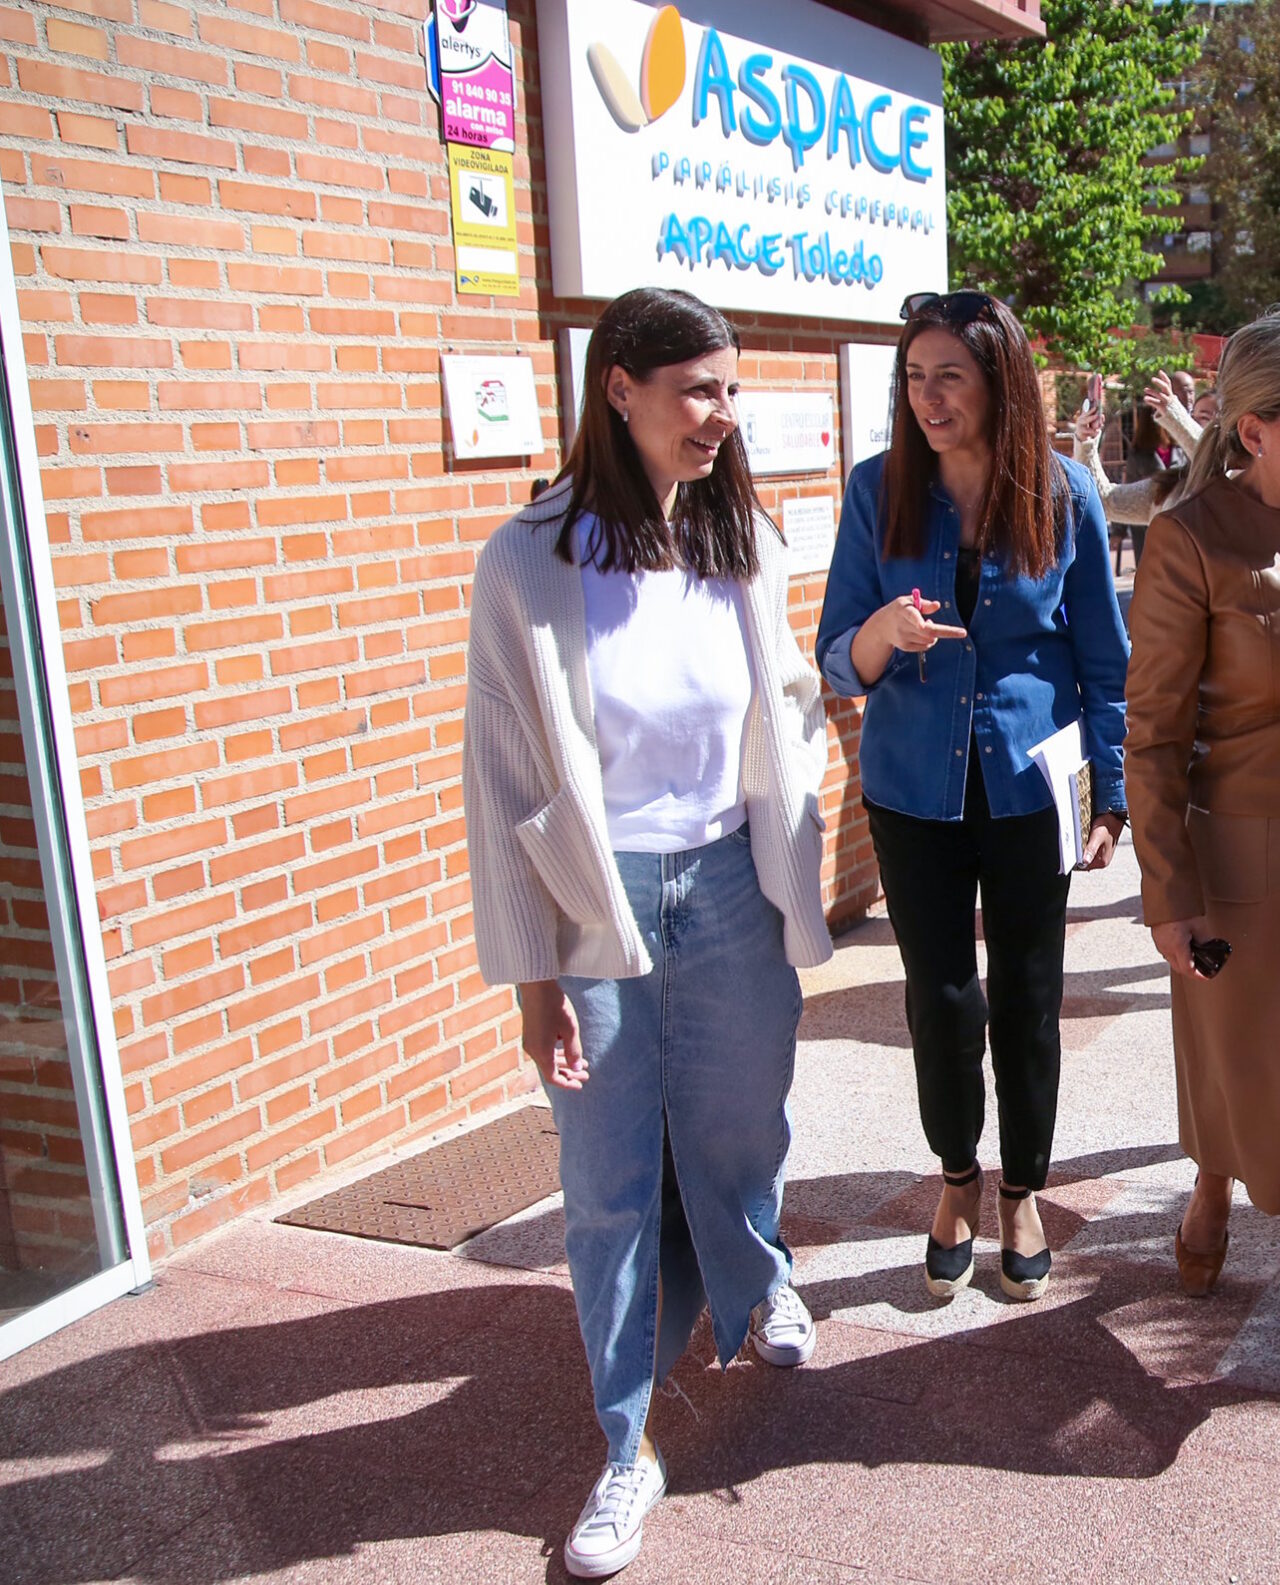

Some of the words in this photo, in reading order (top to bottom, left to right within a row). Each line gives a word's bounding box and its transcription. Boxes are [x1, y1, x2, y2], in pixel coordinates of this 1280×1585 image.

[441, 35, 481, 60] alertys
[452, 80, 464, 95] 91
[466, 83, 484, 101] 840
[485, 88, 498, 103] 90
[500, 92, 511, 107] 35
[446, 97, 507, 127] alarma
[447, 124, 459, 137] 24
[461, 127, 488, 143] horas
[453, 157, 509, 174] VIDEOVIGILADA
[470, 150, 491, 161] ZONA
[825, 190, 935, 234] CEREBRAL
[657, 212, 785, 276] APACE
[787, 231, 883, 290] Toledo
